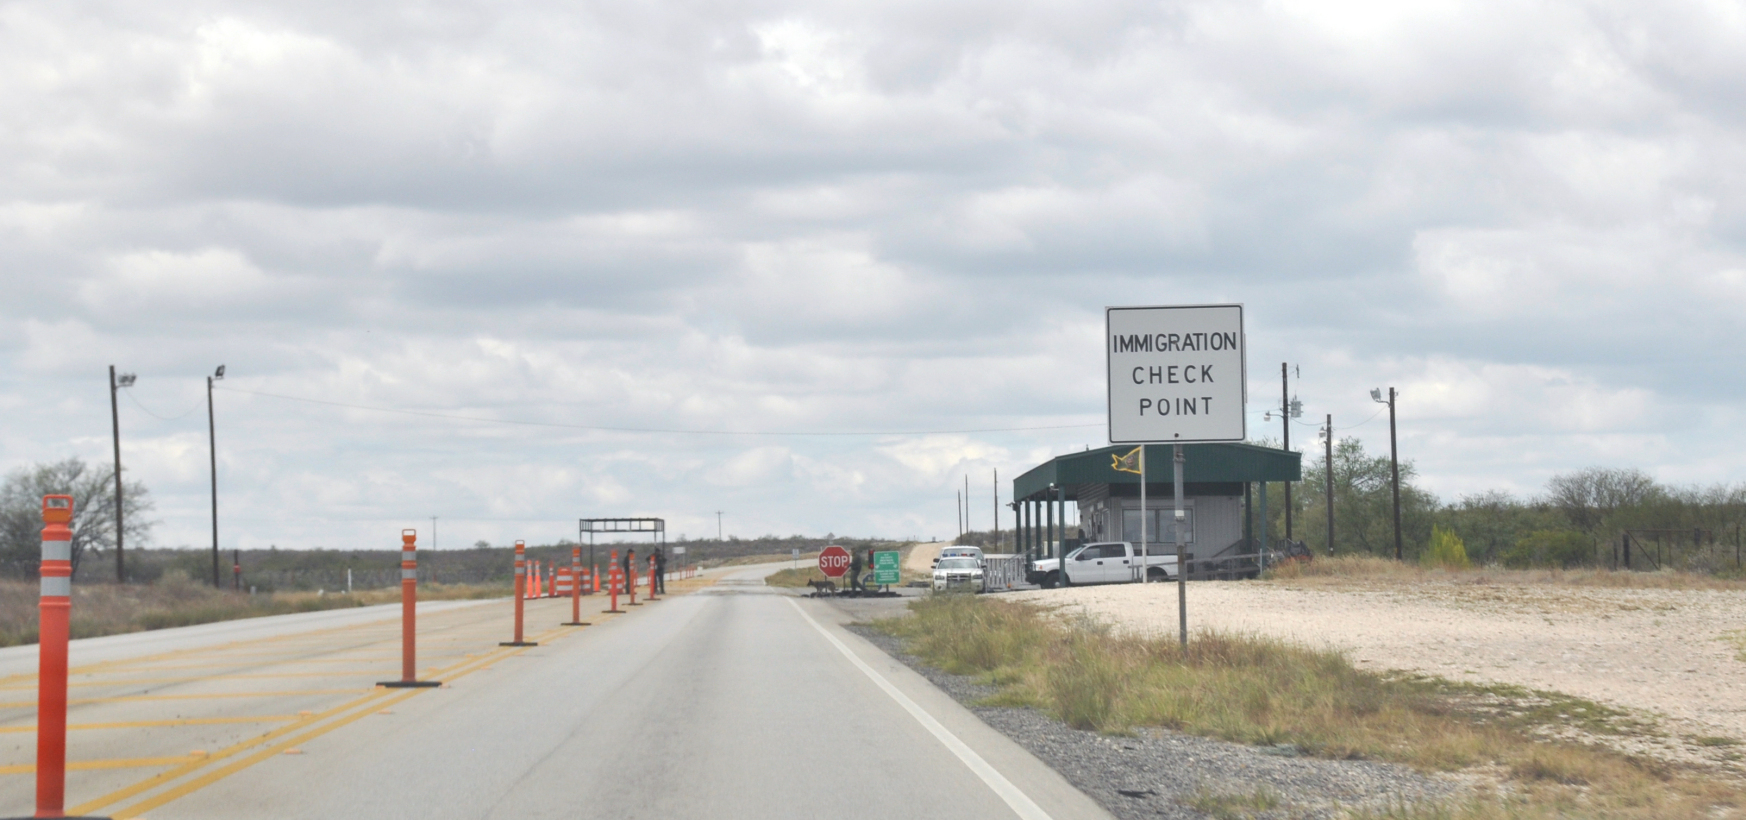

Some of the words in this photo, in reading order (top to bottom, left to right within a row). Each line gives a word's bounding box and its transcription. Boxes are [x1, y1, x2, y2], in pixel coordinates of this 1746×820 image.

[1113, 331, 1237, 354] IMMIGRATION
[1132, 364, 1214, 385] CHECK
[1139, 396, 1213, 417] POINT
[821, 555, 848, 568] STOP
